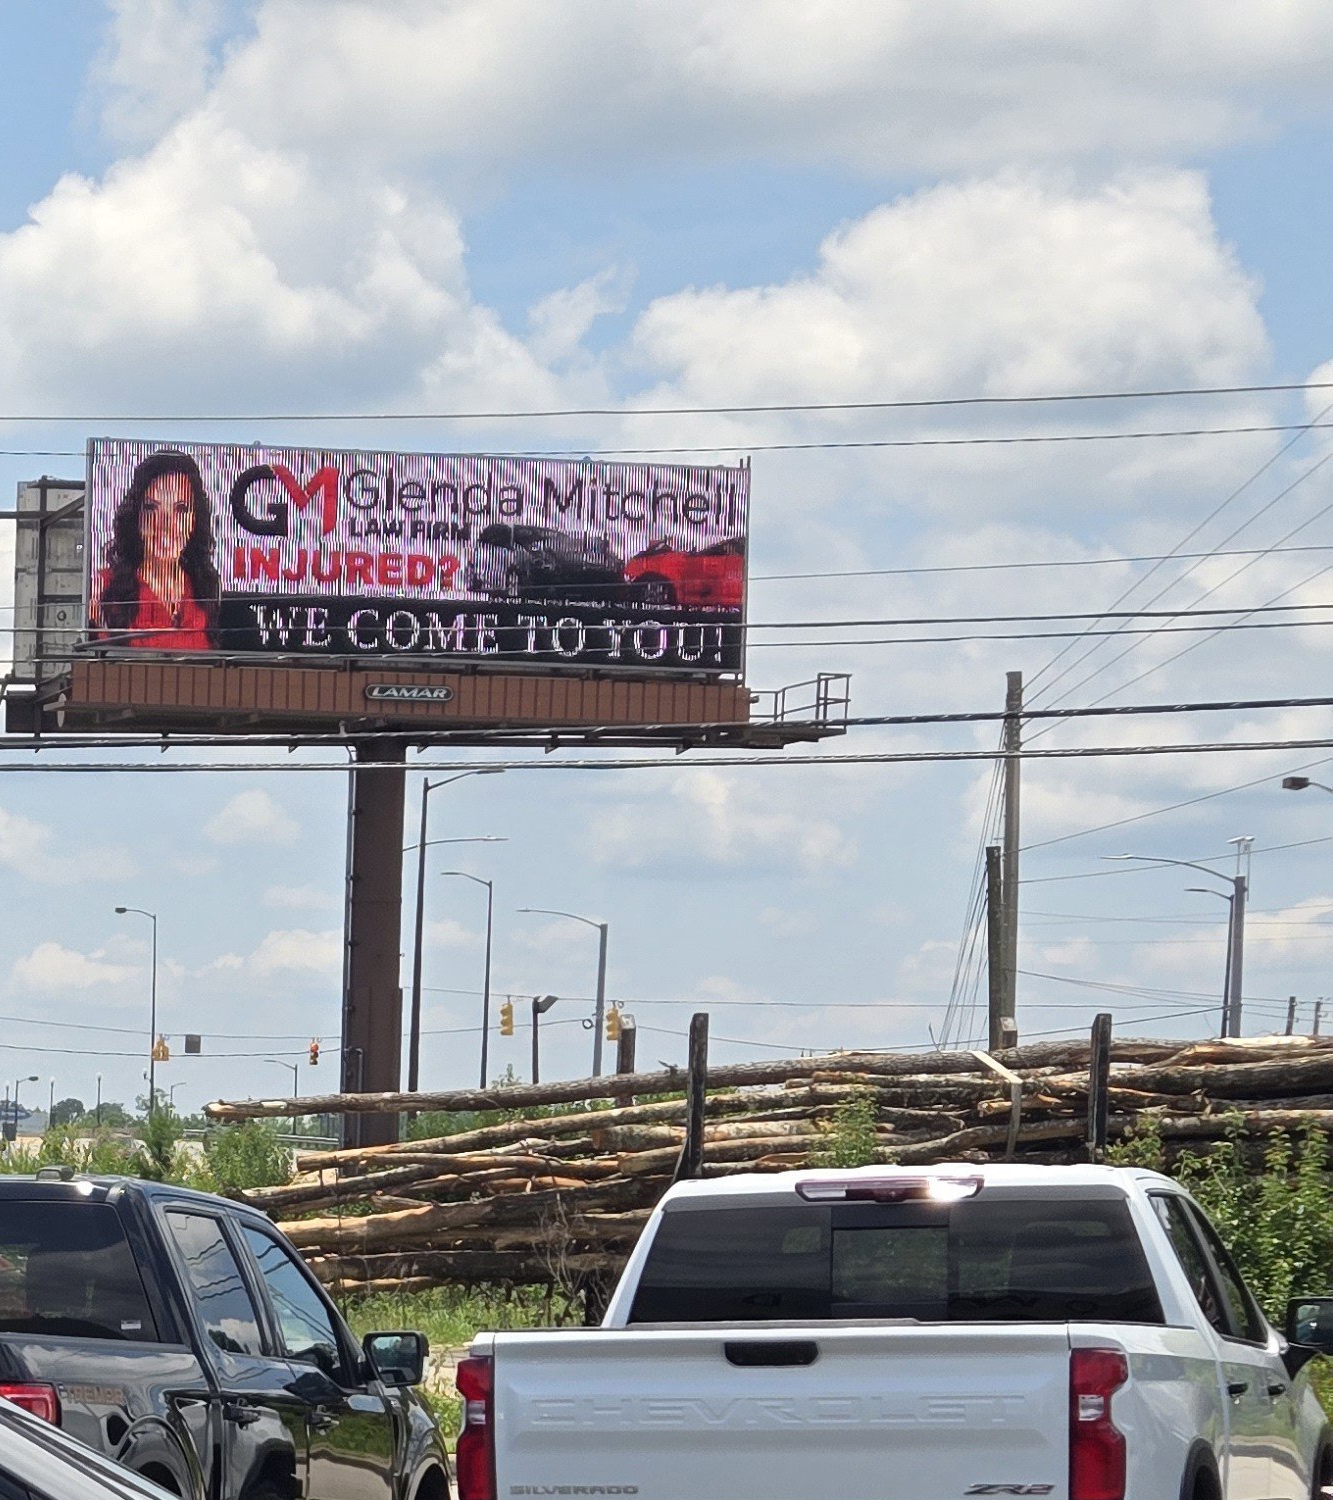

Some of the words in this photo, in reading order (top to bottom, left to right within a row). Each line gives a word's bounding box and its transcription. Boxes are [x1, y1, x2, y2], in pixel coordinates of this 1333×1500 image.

[343, 467, 524, 517] Glenda
[543, 476, 736, 527] Mitchell
[349, 517, 403, 538] LAW
[409, 520, 472, 542] FIRM
[234, 547, 462, 589] INJURED?
[249, 603, 332, 647] WE
[347, 608, 500, 655] COME
[518, 613, 585, 657] TO
[603, 618, 723, 663] YOU!
[371, 685, 449, 699] LAMAR
[530, 1395, 1026, 1424] CHEVROLET
[509, 1484, 639, 1495] SILVERADO
[963, 1483, 1056, 1496] ZR2
